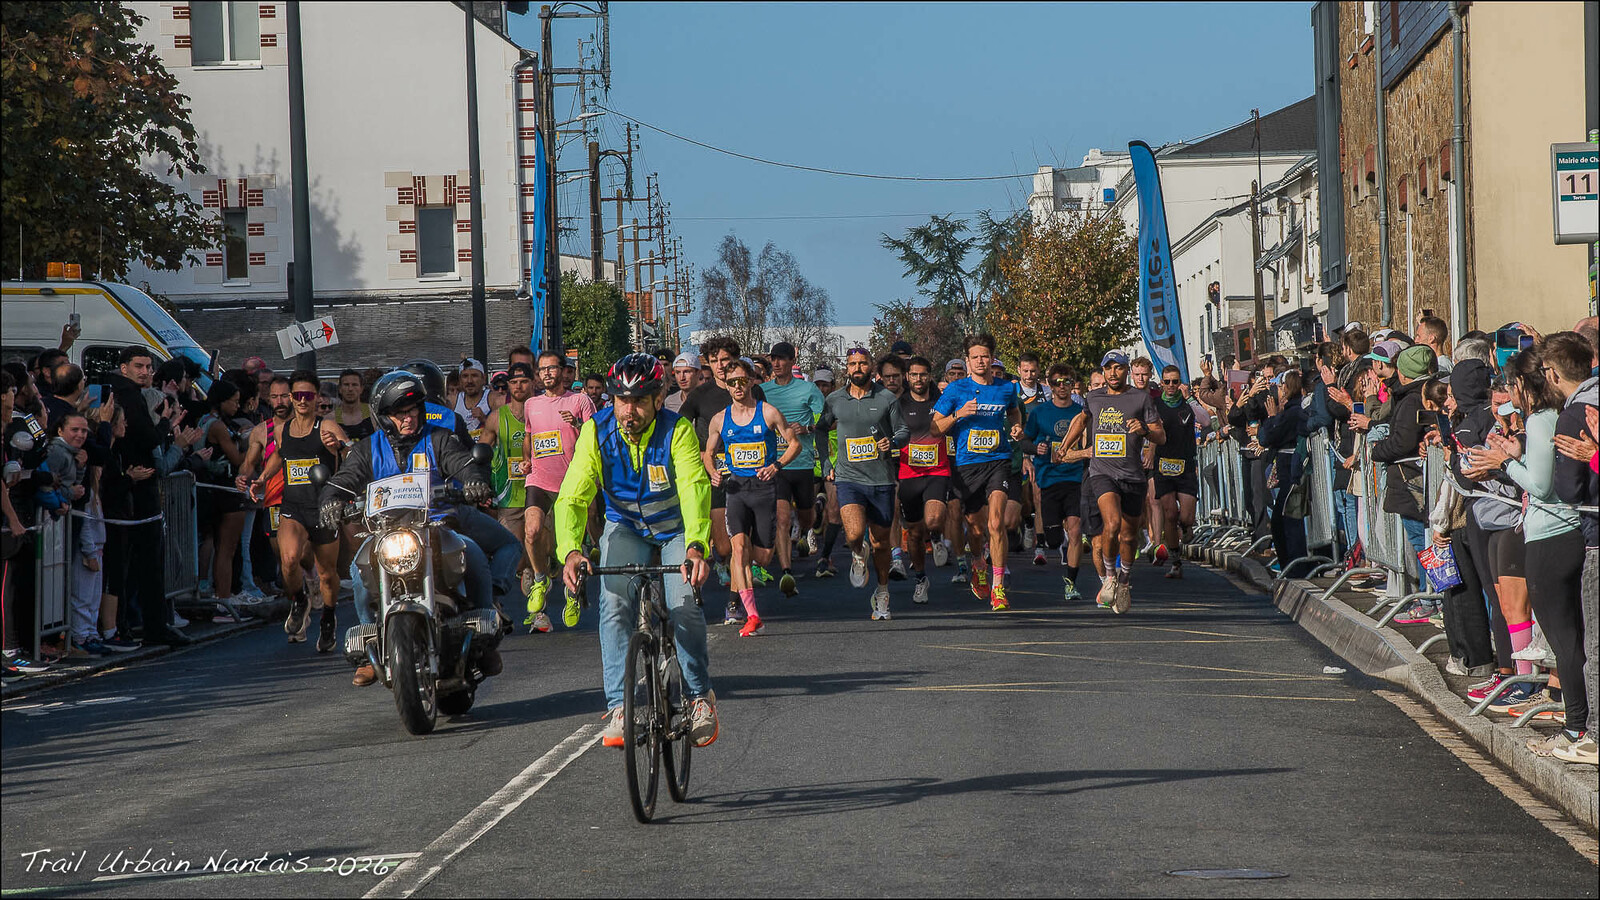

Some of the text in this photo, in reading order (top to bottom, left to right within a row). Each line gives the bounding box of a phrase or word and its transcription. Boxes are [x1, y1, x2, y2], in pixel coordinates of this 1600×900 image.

[1566, 173, 1591, 193] 11
[425, 412, 443, 420] TION
[534, 437, 557, 450] 2435
[973, 437, 994, 446] 2103
[1100, 441, 1120, 450] 2327
[851, 443, 873, 455] 2000
[736, 450, 759, 460] 2758
[913, 450, 934, 460] 2635
[291, 467, 310, 477] 304
[393, 486, 425, 494] SERVICE
